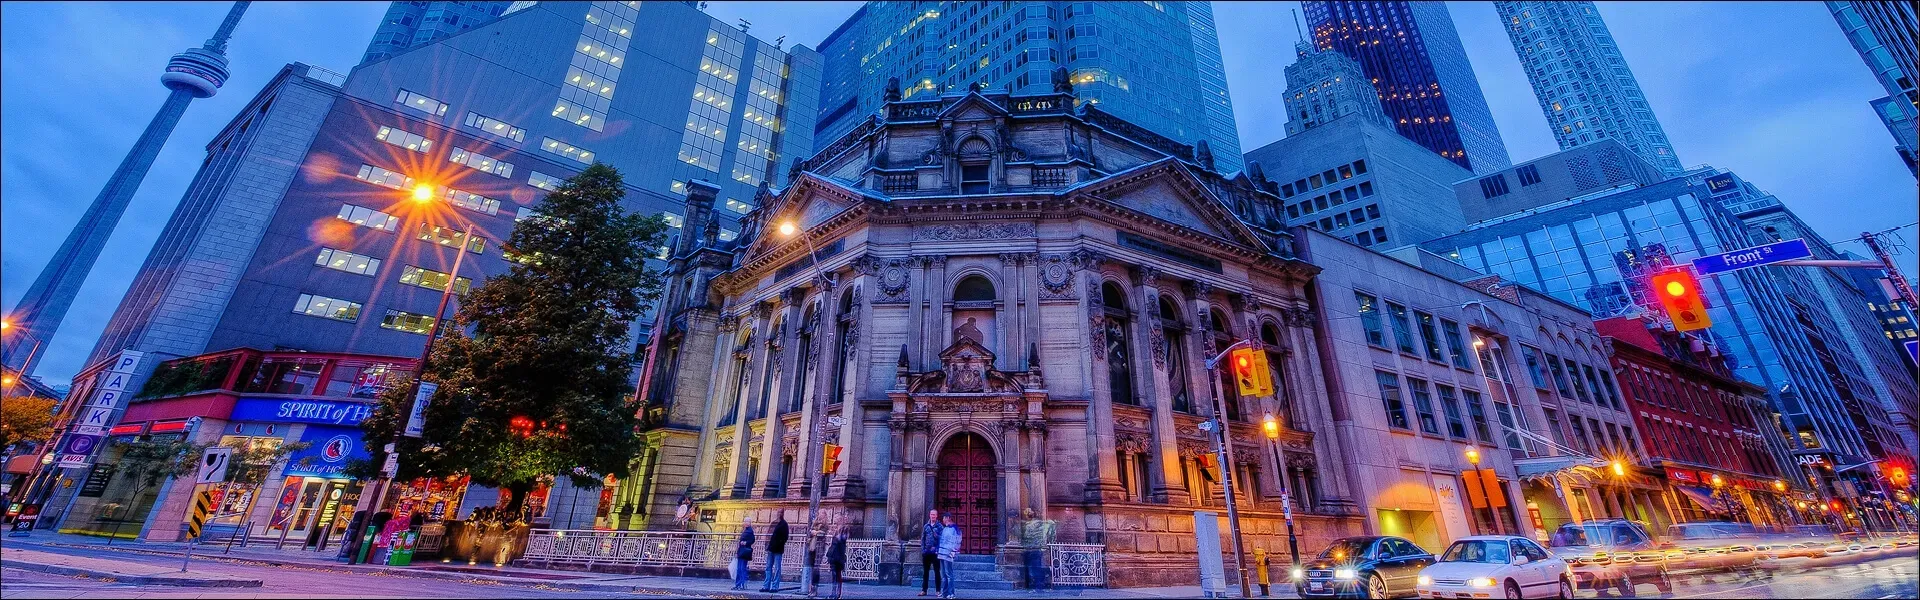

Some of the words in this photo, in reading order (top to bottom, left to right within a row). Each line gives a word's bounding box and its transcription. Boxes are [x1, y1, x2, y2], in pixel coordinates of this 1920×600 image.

[1722, 249, 1764, 266] Front
[1763, 246, 1774, 254] St
[90, 358, 134, 424] PARK
[277, 401, 335, 420] SPIRIT
[332, 404, 354, 425] of
[290, 463, 319, 472] SPIRIT
[317, 464, 328, 474] of
[1795, 454, 1824, 465] ADE
